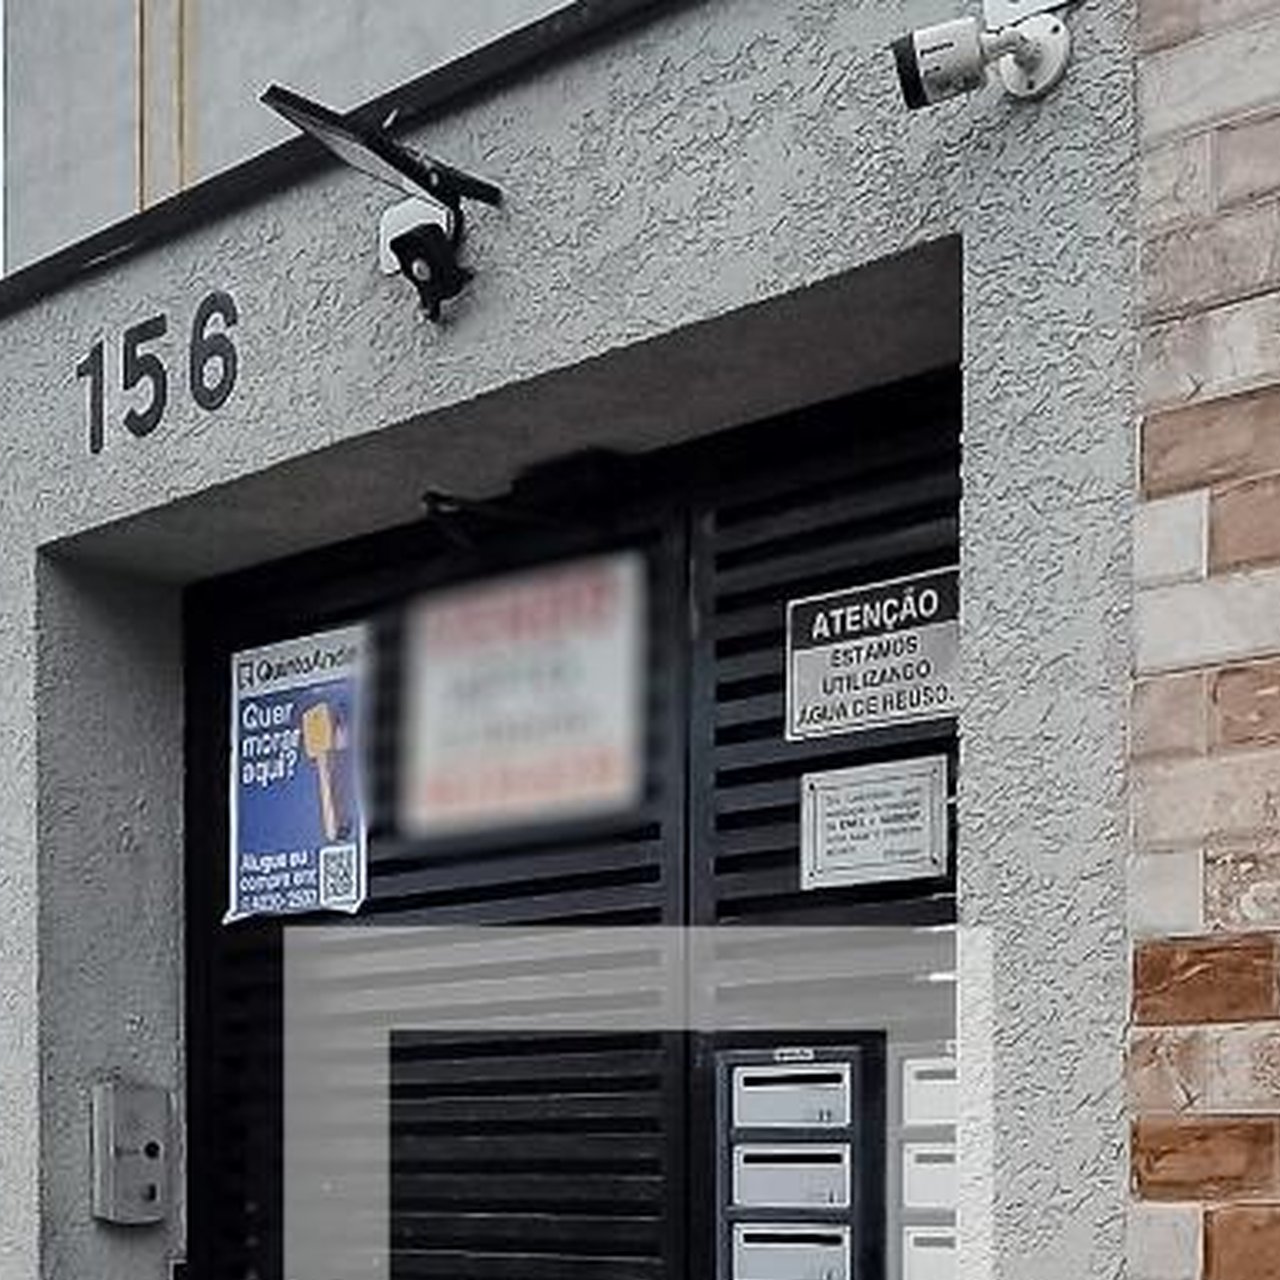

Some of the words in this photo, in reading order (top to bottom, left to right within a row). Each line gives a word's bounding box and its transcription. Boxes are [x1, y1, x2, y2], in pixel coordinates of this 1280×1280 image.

[76, 290, 238, 454] 156
[812, 586, 938, 639] ATENÇÃO
[830, 636, 918, 668] ESTAMOS
[822, 659, 931, 696] UTILIZANDO
[242, 703, 294, 729] Quer
[852, 697, 878, 717] DE
[242, 750, 297, 787] aqui?
